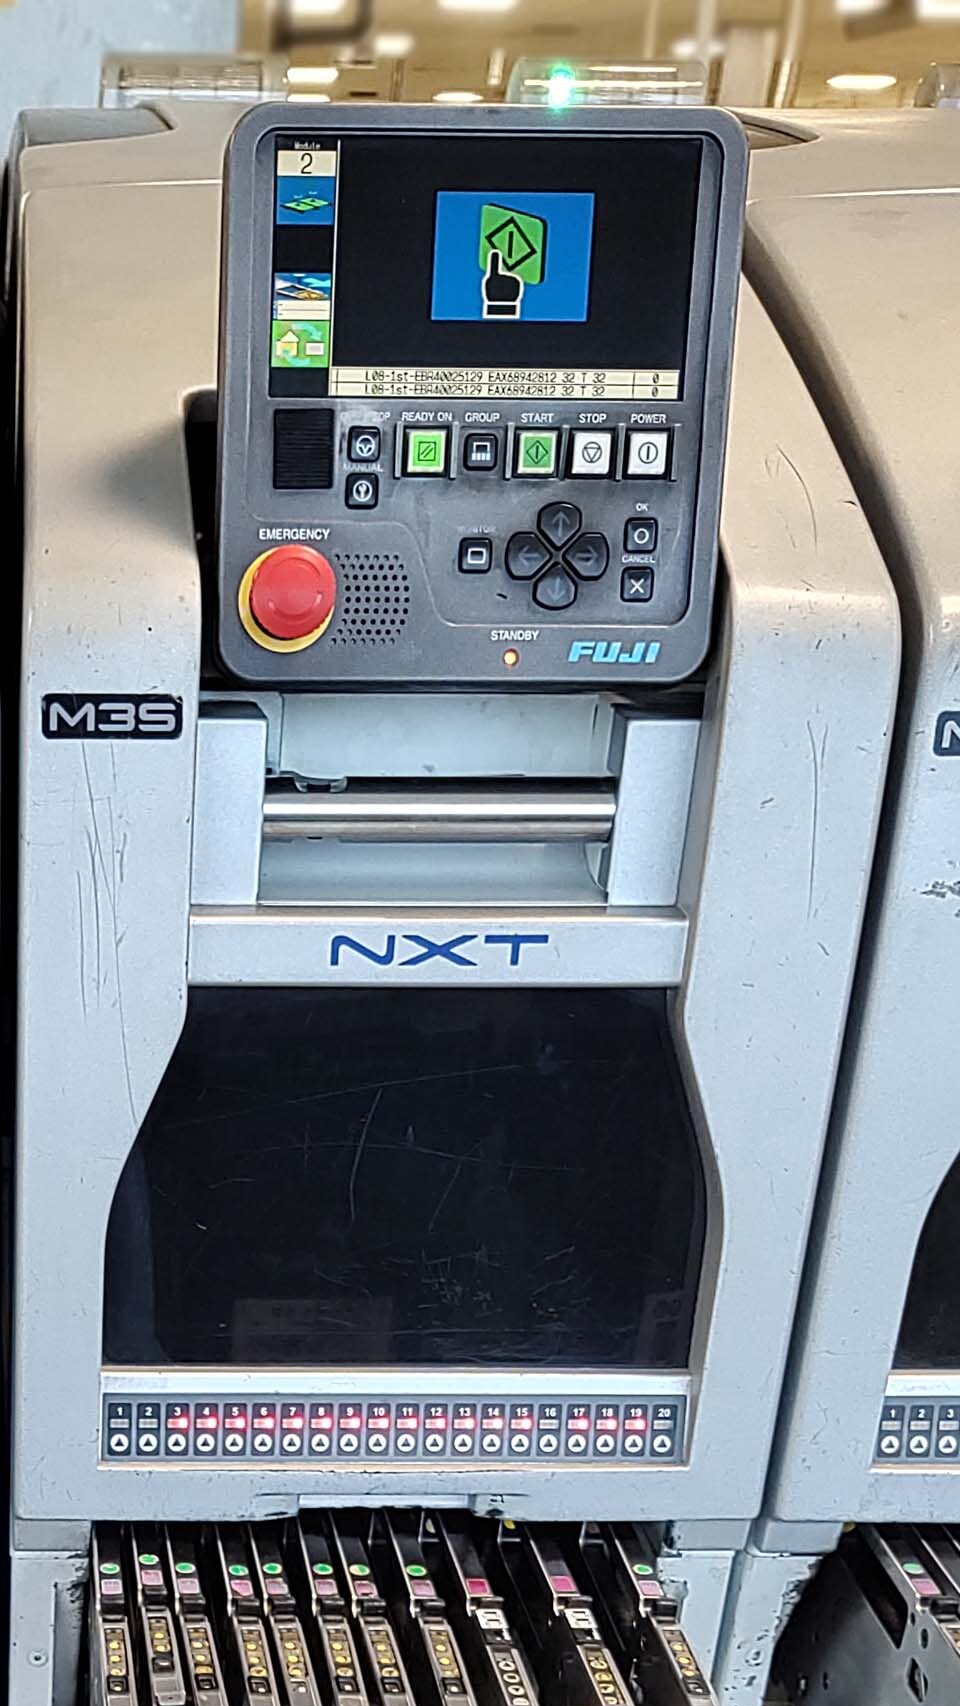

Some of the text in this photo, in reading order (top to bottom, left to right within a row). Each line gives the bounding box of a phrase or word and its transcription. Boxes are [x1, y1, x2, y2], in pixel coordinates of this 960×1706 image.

[300, 152, 314, 175] 2
[401, 411, 452, 422] READY ON
[464, 411, 500, 423] GROUP
[520, 412, 554, 423] START
[578, 413, 607, 424] STOP
[630, 413, 667, 424] POWER
[635, 502, 649, 512] OK
[258, 528, 330, 541] EMERGENCY
[621, 554, 656, 564] CANCEL
[490, 629, 539, 641] STANDBY
[567, 641, 661, 664] FUJI
[49, 701, 176, 733] M3S
[330, 934, 549, 967] NXT
[373, 1407, 386, 1416] 10
[402, 1407, 413, 1417] 11
[430, 1407, 443, 1417] 12
[458, 1407, 471, 1417] 13
[487, 1407, 500, 1417] 14
[516, 1407, 528, 1417] 15
[544, 1407, 556, 1417] 16
[572, 1407, 585, 1417] 17
[601, 1408, 614, 1417] 18
[630, 1408, 642, 1417] 19
[658, 1408, 671, 1417] 20
[918, 1409, 925, 1418] 2
[946, 1409, 954, 1418] 3
